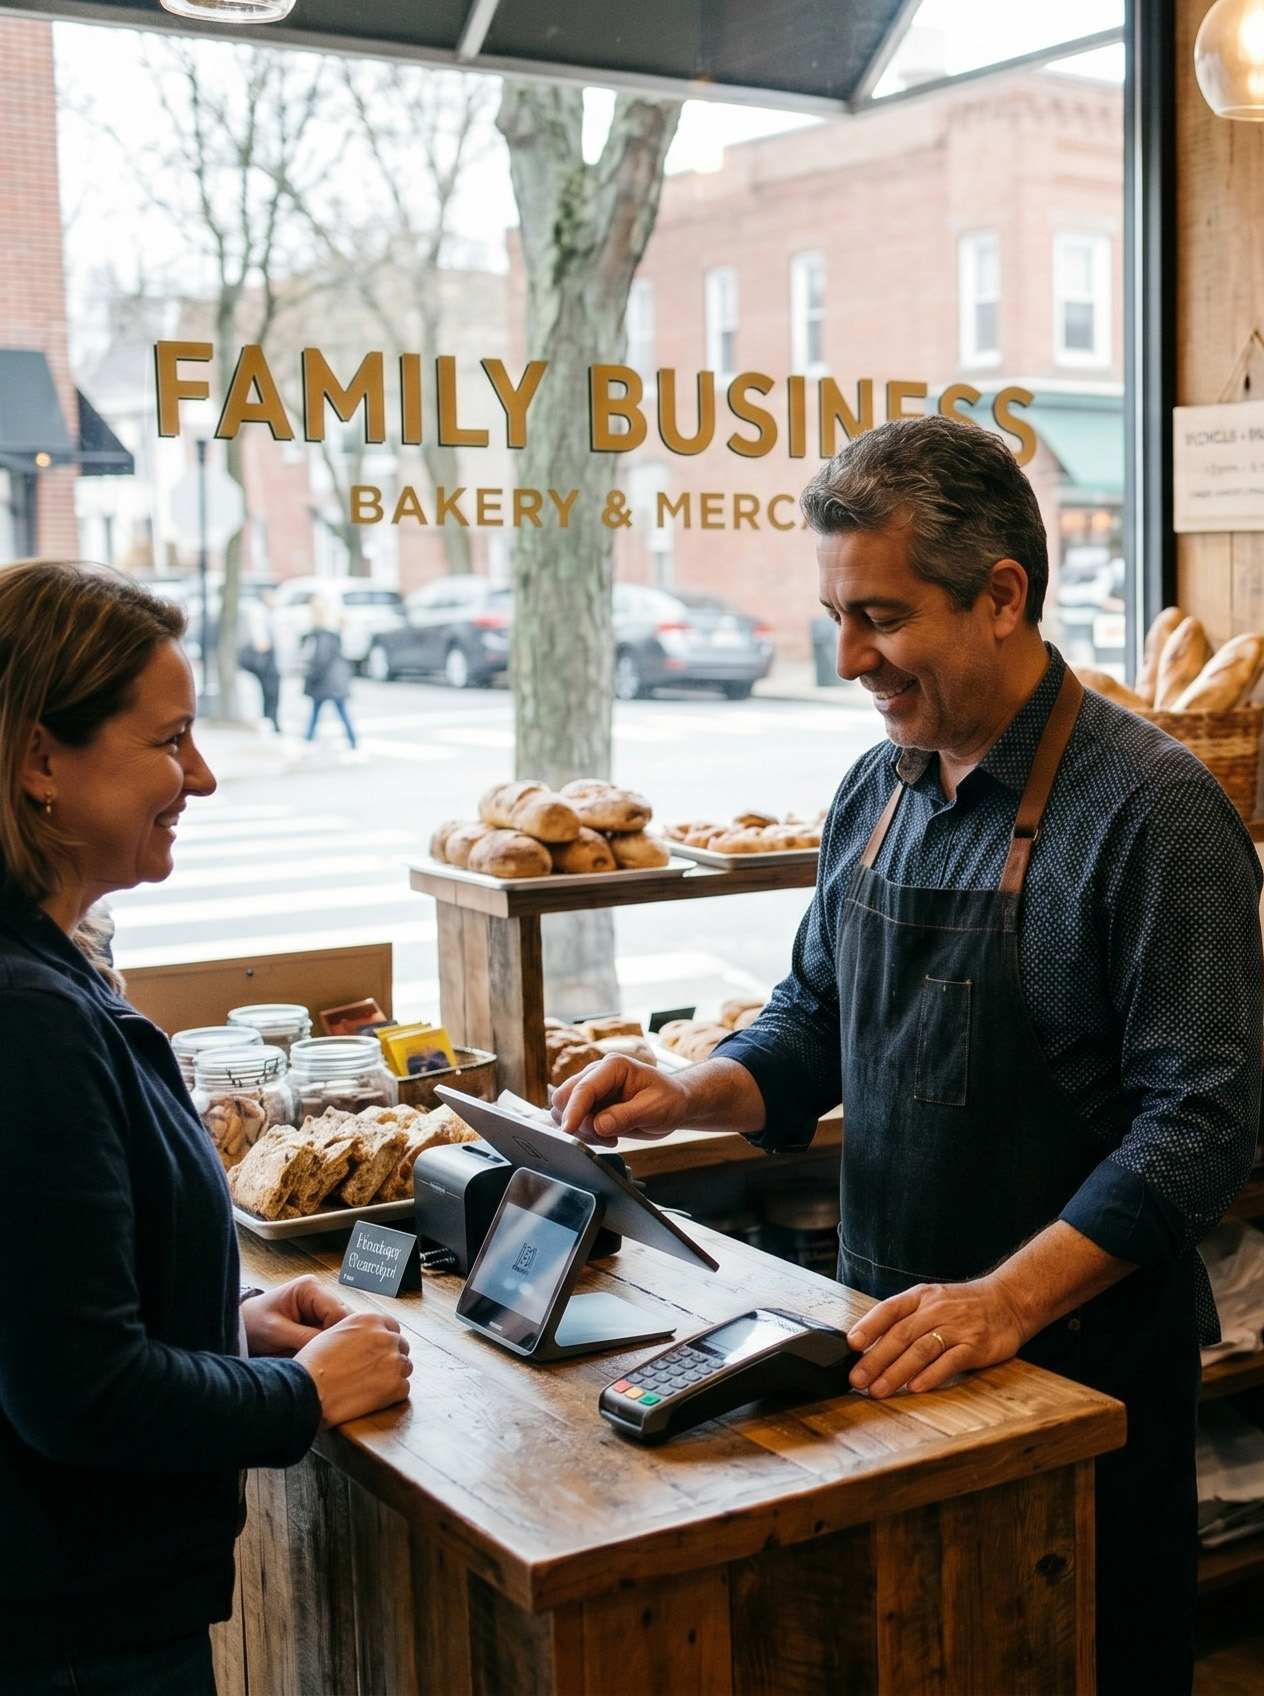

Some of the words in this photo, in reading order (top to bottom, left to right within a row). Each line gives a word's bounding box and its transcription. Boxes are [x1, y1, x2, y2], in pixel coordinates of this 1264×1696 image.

[153, 339, 549, 449] FAMILY
[350, 485, 580, 529] BAKERY
[602, 489, 633, 530] &
[656, 491, 810, 531] MERC
